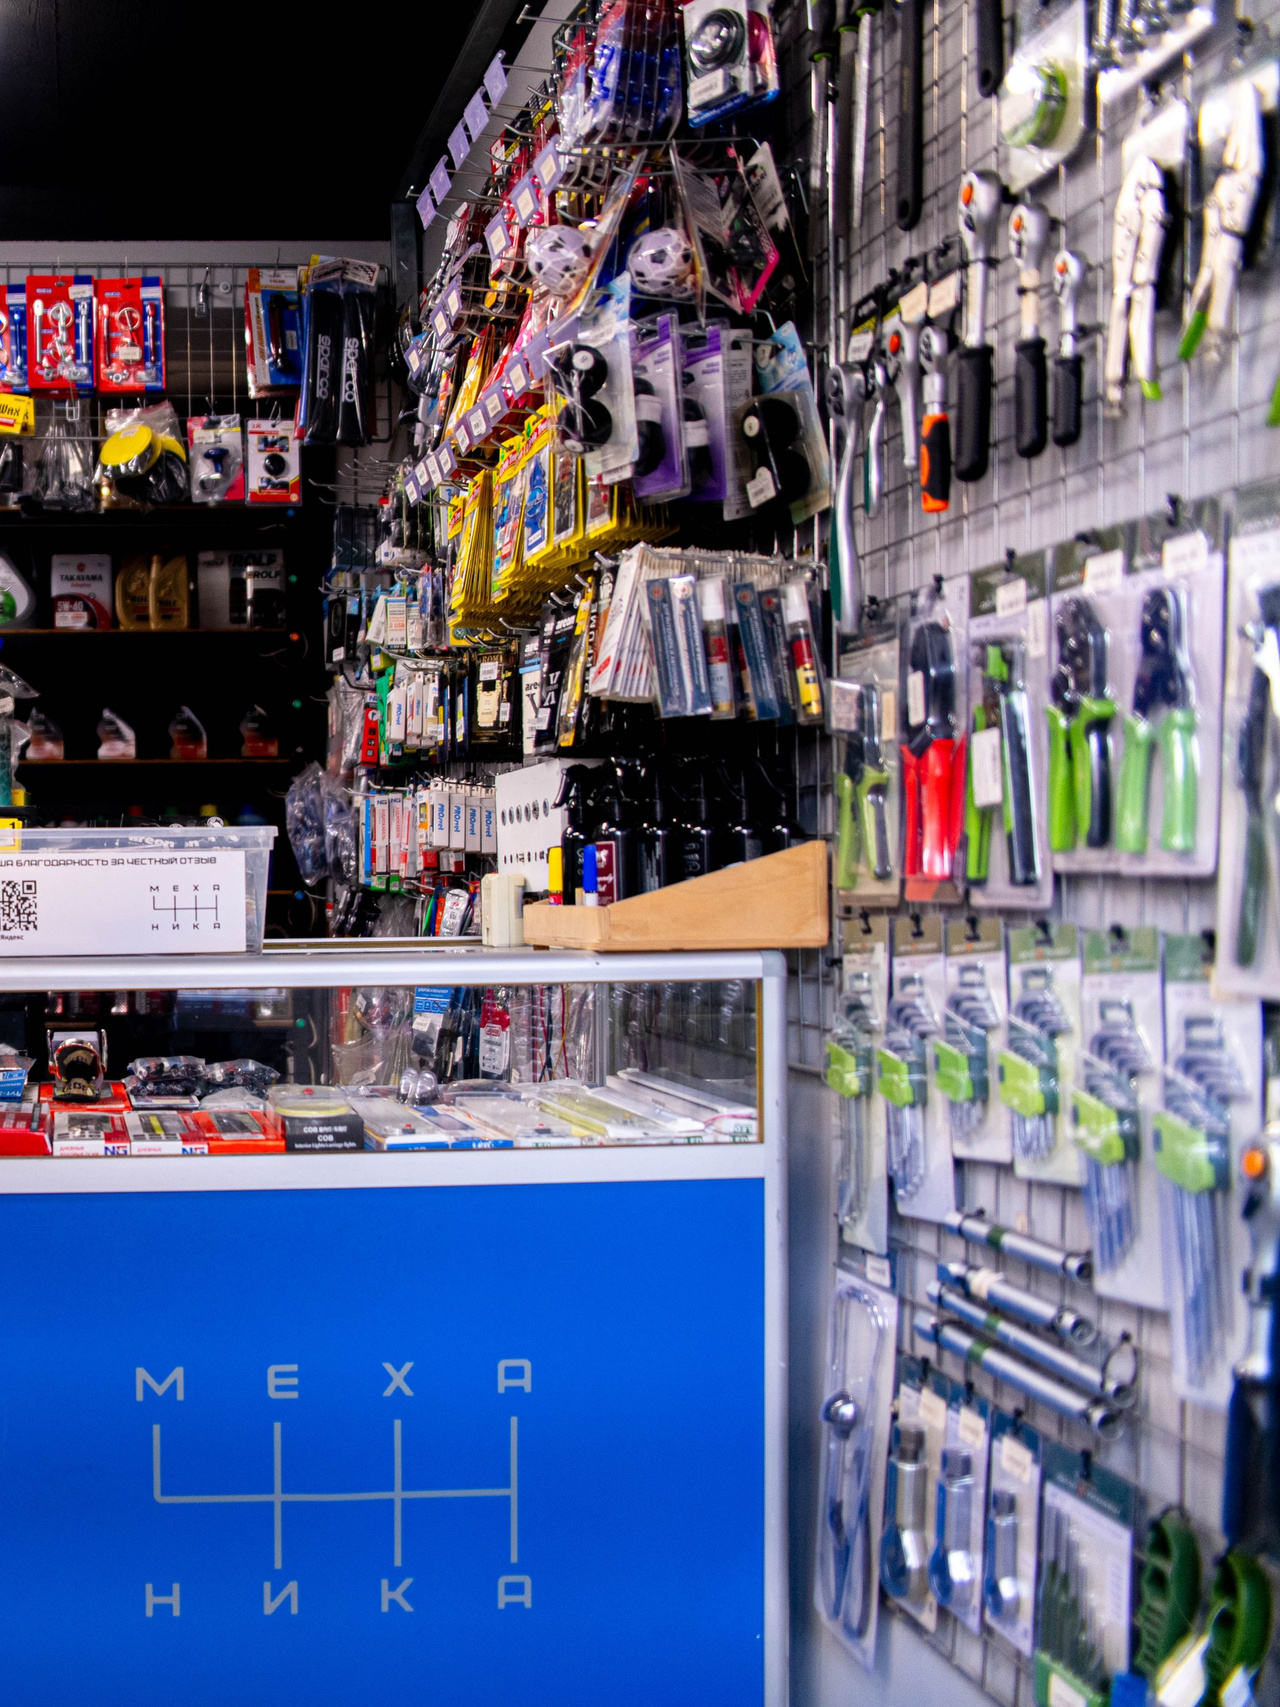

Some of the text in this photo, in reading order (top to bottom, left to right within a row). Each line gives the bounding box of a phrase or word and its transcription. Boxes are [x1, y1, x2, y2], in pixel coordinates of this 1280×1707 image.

[317, 334, 331, 399] sparco
[344, 338, 359, 402] sparco
[60, 574, 102, 582] TAKAYAMA
[253, 570, 280, 579] ROLF
[57, 602, 83, 612] 5W-40
[16, 858, 108, 867] БЛАГОДАРНОСТЬ
[127, 857, 178, 866] ЧЕСТНЫЙ
[180, 857, 216, 865] ОТЗЫВ
[104, 1146, 128, 1155] NG
